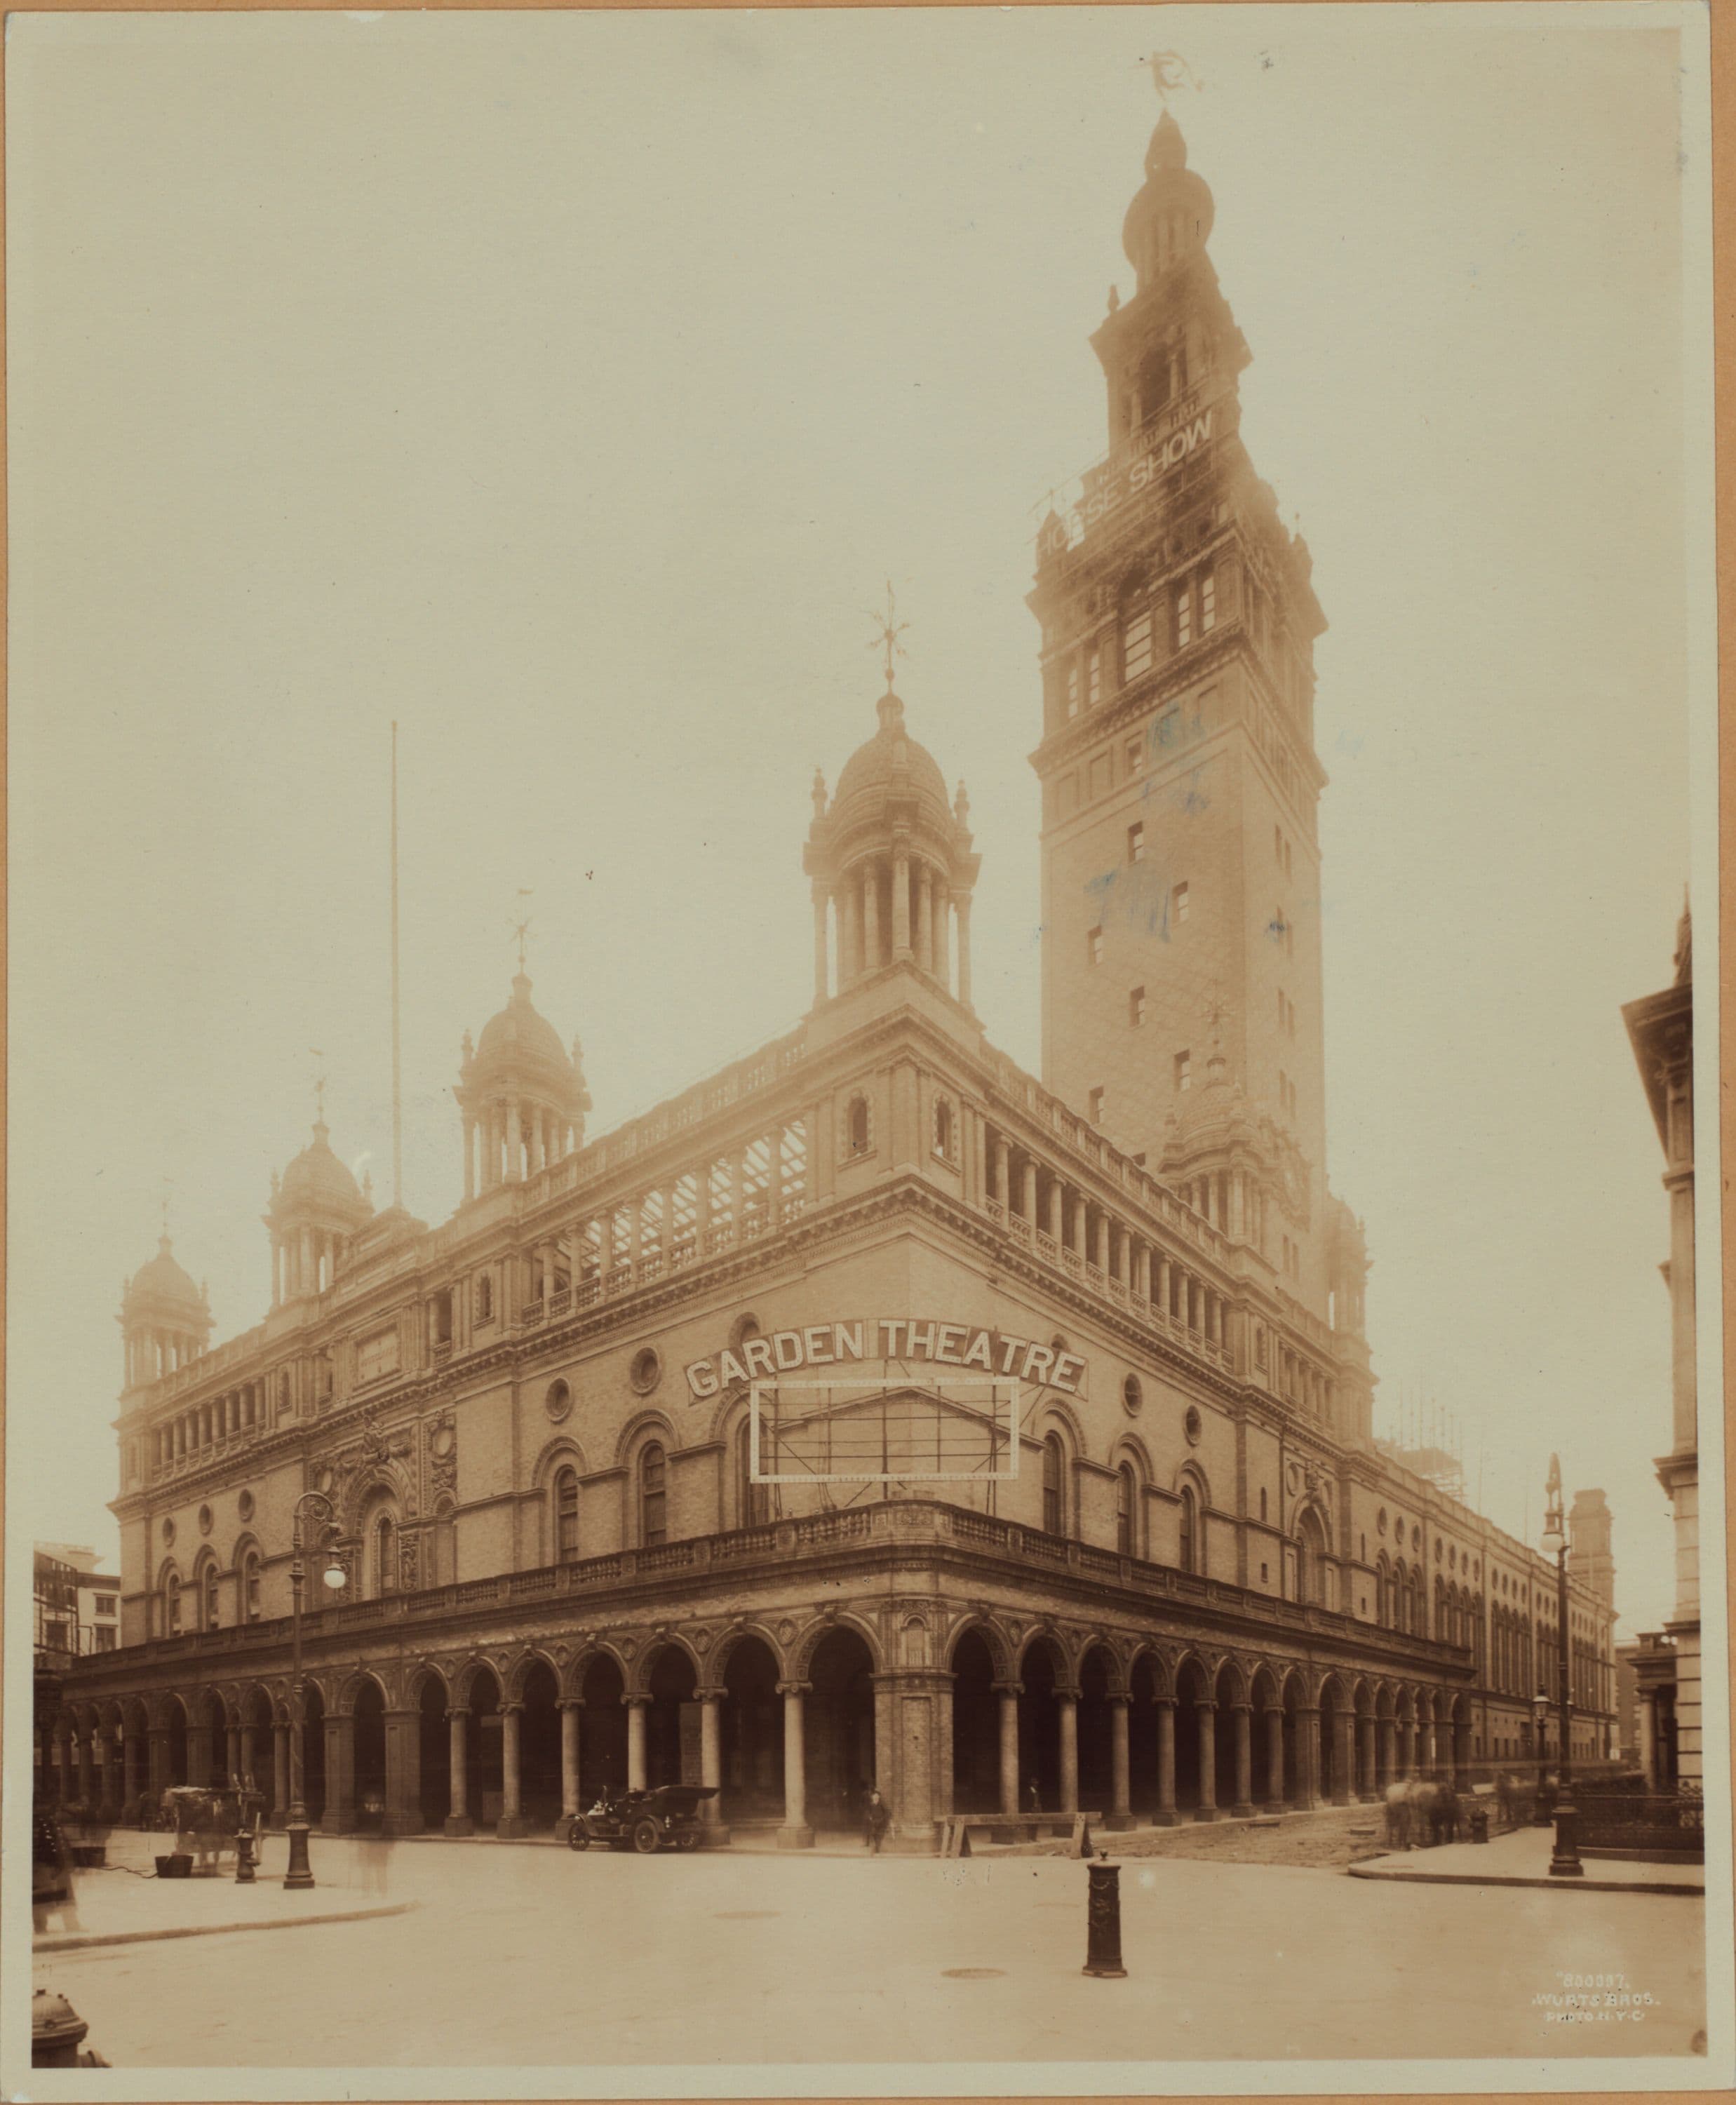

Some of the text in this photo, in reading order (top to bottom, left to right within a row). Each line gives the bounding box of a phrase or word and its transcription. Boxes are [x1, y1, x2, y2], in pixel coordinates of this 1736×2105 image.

[1129, 410, 1212, 492] SHOW
[685, 1319, 1086, 1398] GARDEN THEATRE
